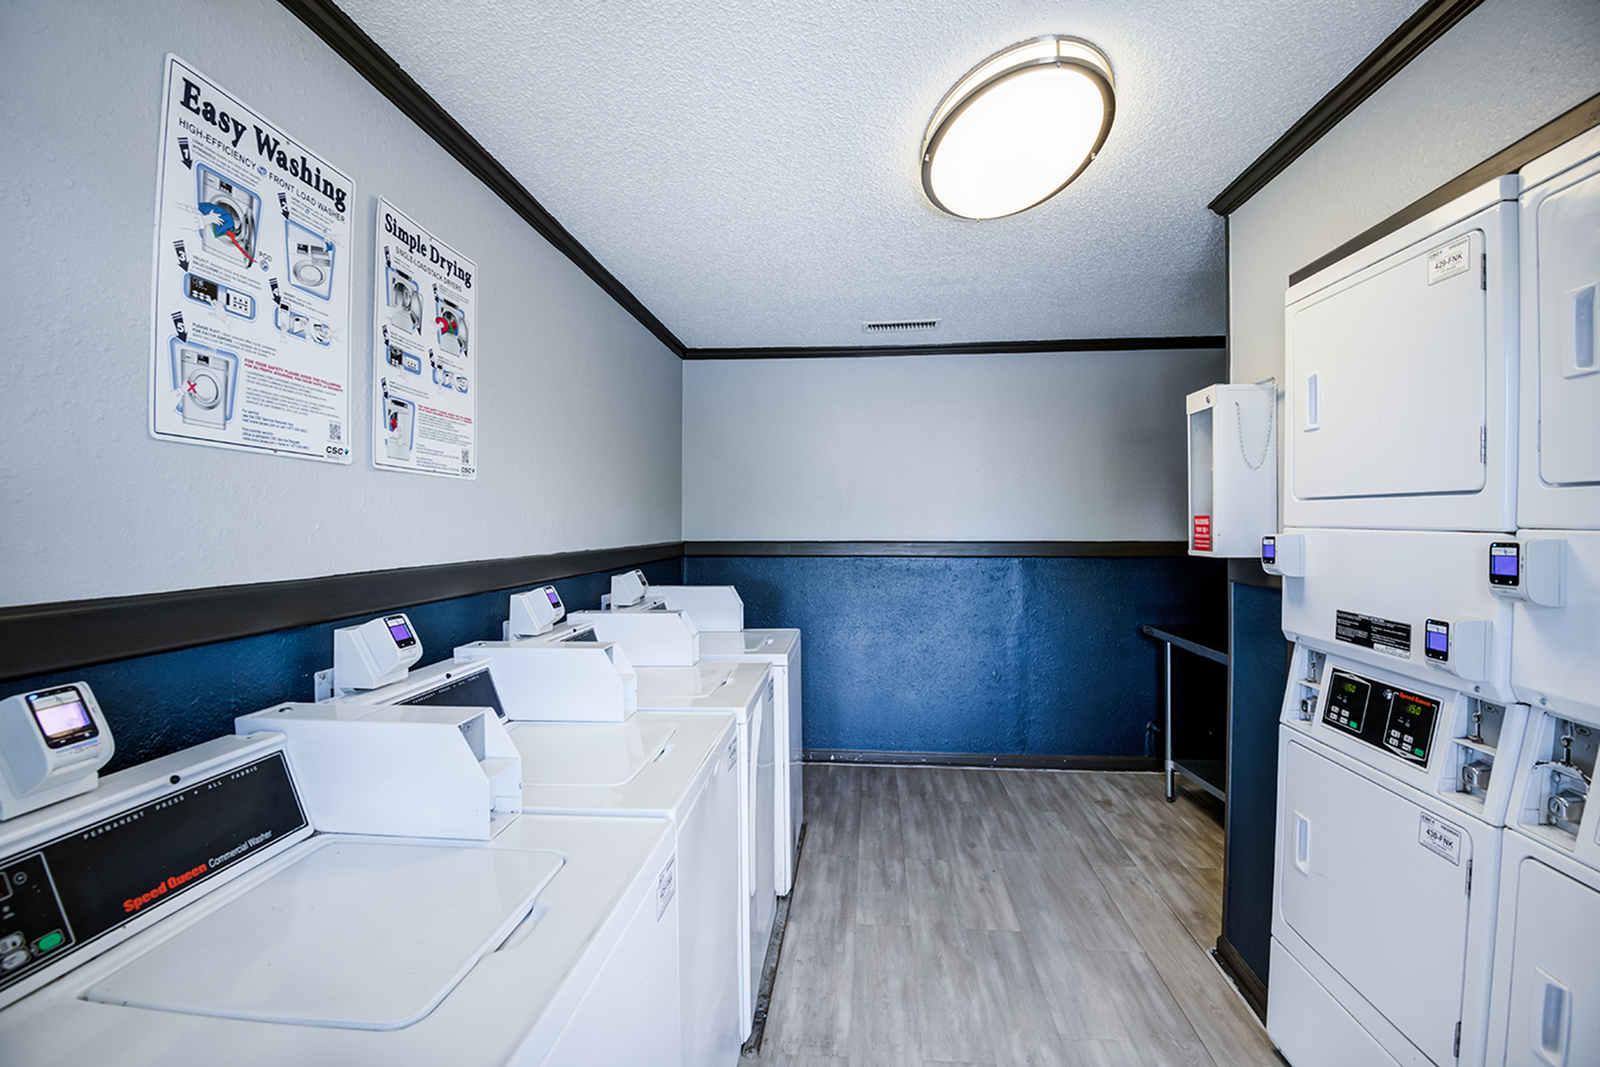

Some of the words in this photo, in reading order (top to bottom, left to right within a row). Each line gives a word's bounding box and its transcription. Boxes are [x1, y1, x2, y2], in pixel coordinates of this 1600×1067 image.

[178, 117, 257, 170] HIGH-EFFICIENCY
[269, 172, 295, 193] FRONT
[296, 189, 316, 206] LOAD
[180, 77, 247, 148] Easy
[253, 124, 347, 213] Washing
[385, 213, 427, 257] Simple
[430, 244, 472, 289] Drying
[177, 322, 185, 333] 5
[326, 446, 344, 455] CSC
[1408, 704, 1422, 716] 150
[83, 811, 144, 840] PERMANENT
[155, 795, 185, 810] PRESS
[208, 780, 223, 790] ALL
[231, 766, 258, 780] FABRIC
[123, 881, 168, 913] Speed
[167, 863, 208, 889] Queen
[208, 841, 249, 868] Commercial
[248, 830, 273, 847] Washer
